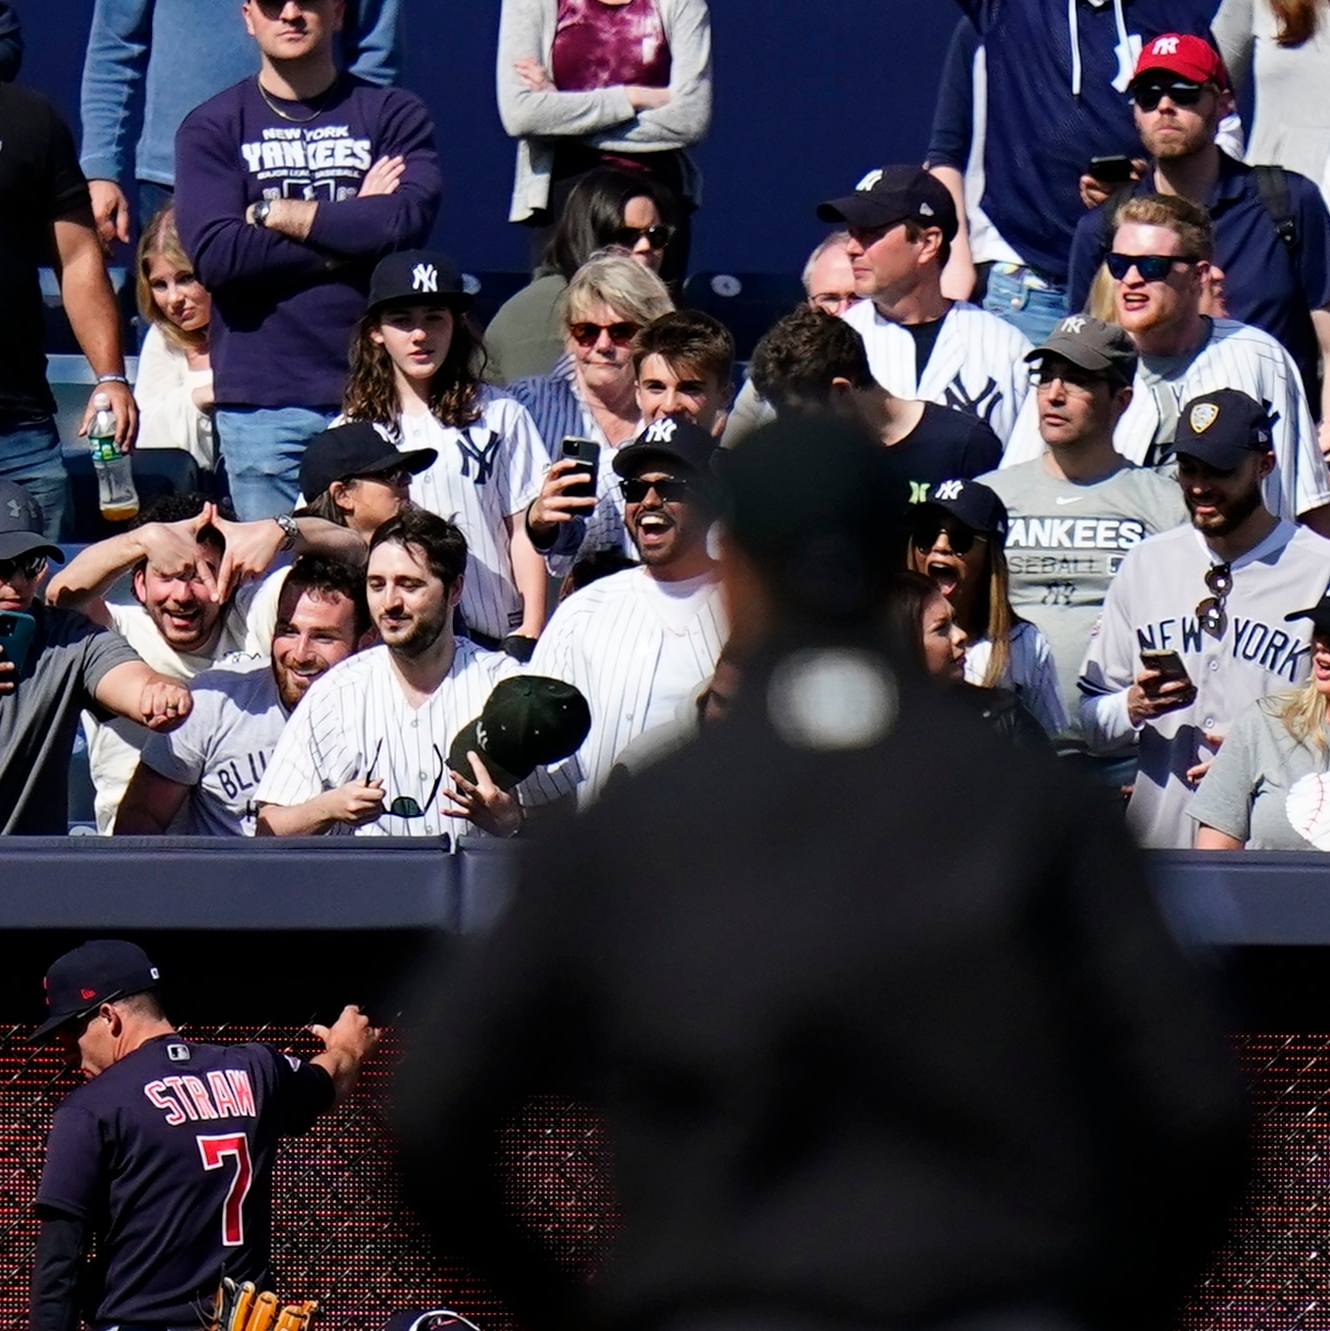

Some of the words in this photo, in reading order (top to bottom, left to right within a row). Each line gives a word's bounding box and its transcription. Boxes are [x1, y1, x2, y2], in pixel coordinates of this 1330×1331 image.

[241, 138, 372, 173] YANKEES
[262, 127, 301, 140] NEW
[302, 125, 350, 141] YORK
[1005, 517, 1146, 550] ANKEES
[1232, 616, 1312, 683] YORK
[144, 1069, 257, 1126] STRAW
[195, 1132, 253, 1247] 7
